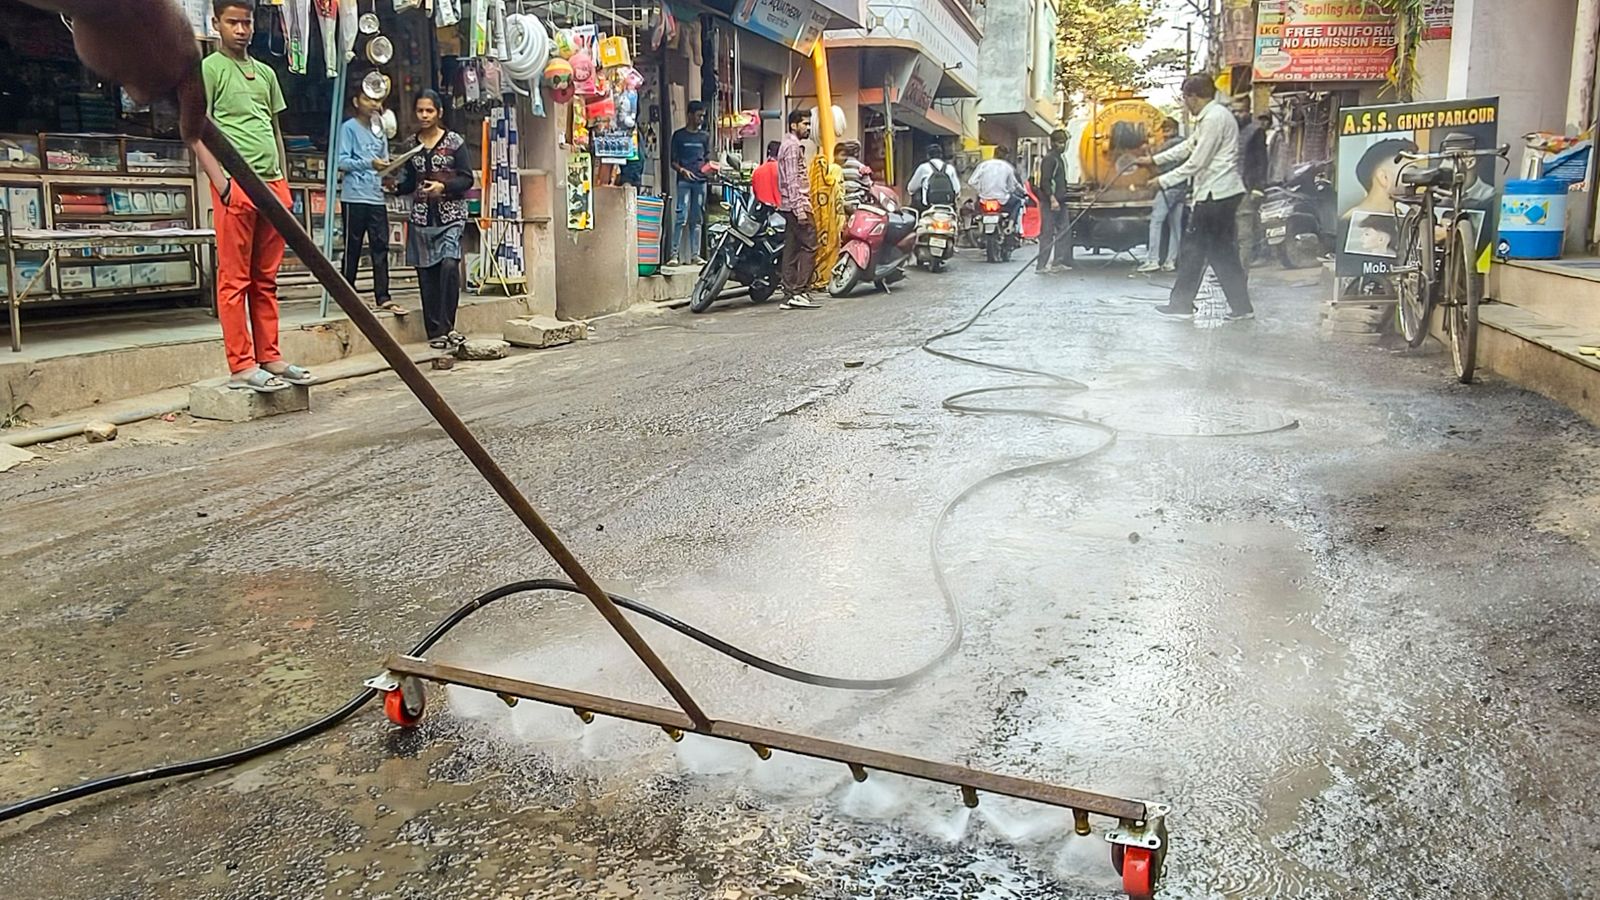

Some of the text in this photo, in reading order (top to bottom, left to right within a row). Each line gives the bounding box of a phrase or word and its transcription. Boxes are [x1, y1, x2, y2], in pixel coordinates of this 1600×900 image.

[1303, 4, 1343, 17] Sapling
[1260, 26, 1280, 35] LKG
[1285, 26, 1394, 37] FREE UNIFORM
[1258, 38, 1280, 47] UKG
[1283, 37, 1395, 48] NO ADMISSION FEE
[1343, 107, 1495, 134] A.S.S. GENTS PARLOUR
[1363, 262, 1390, 275] Mob.
